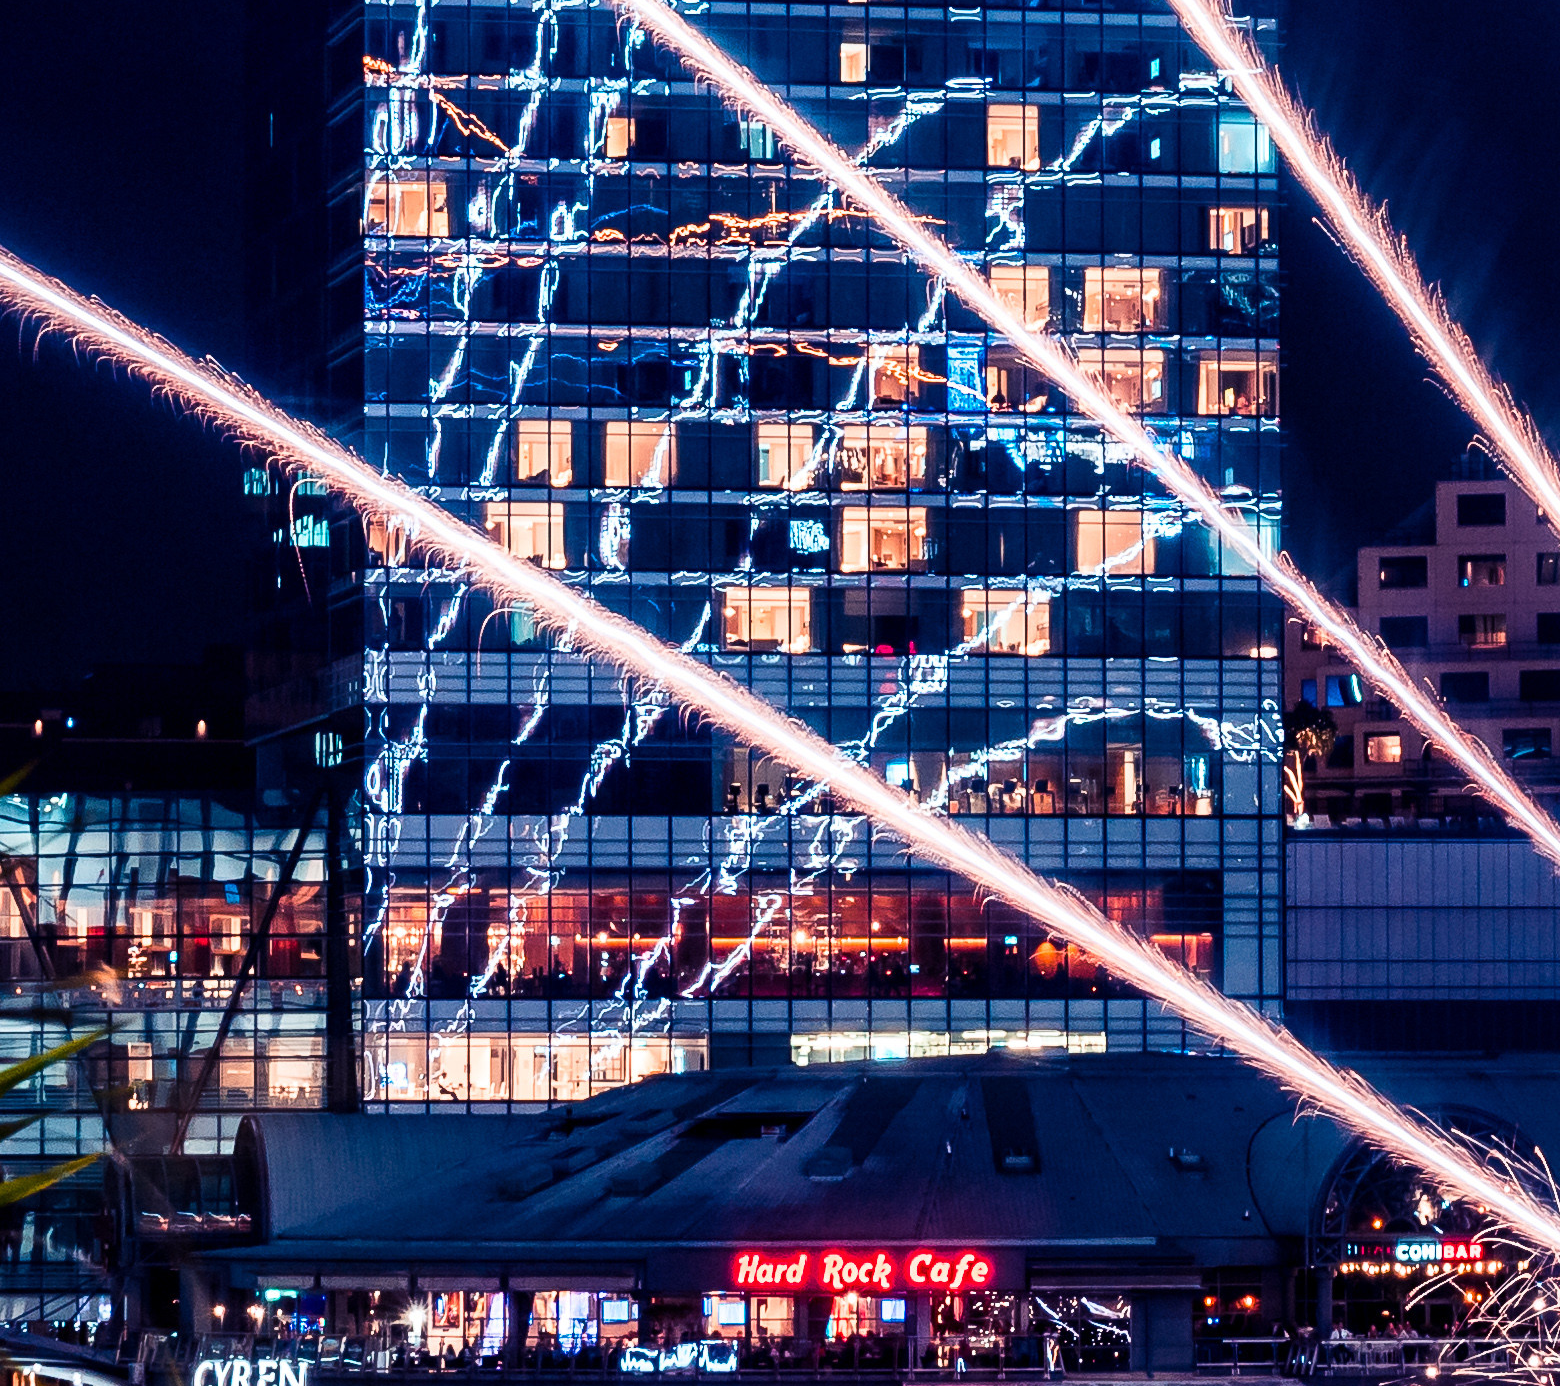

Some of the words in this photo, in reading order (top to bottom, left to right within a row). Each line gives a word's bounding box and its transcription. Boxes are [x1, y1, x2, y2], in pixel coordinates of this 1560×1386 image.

[737, 1253, 808, 1284] Hard
[823, 1253, 892, 1290] Rock
[909, 1253, 989, 1289] Cafe
